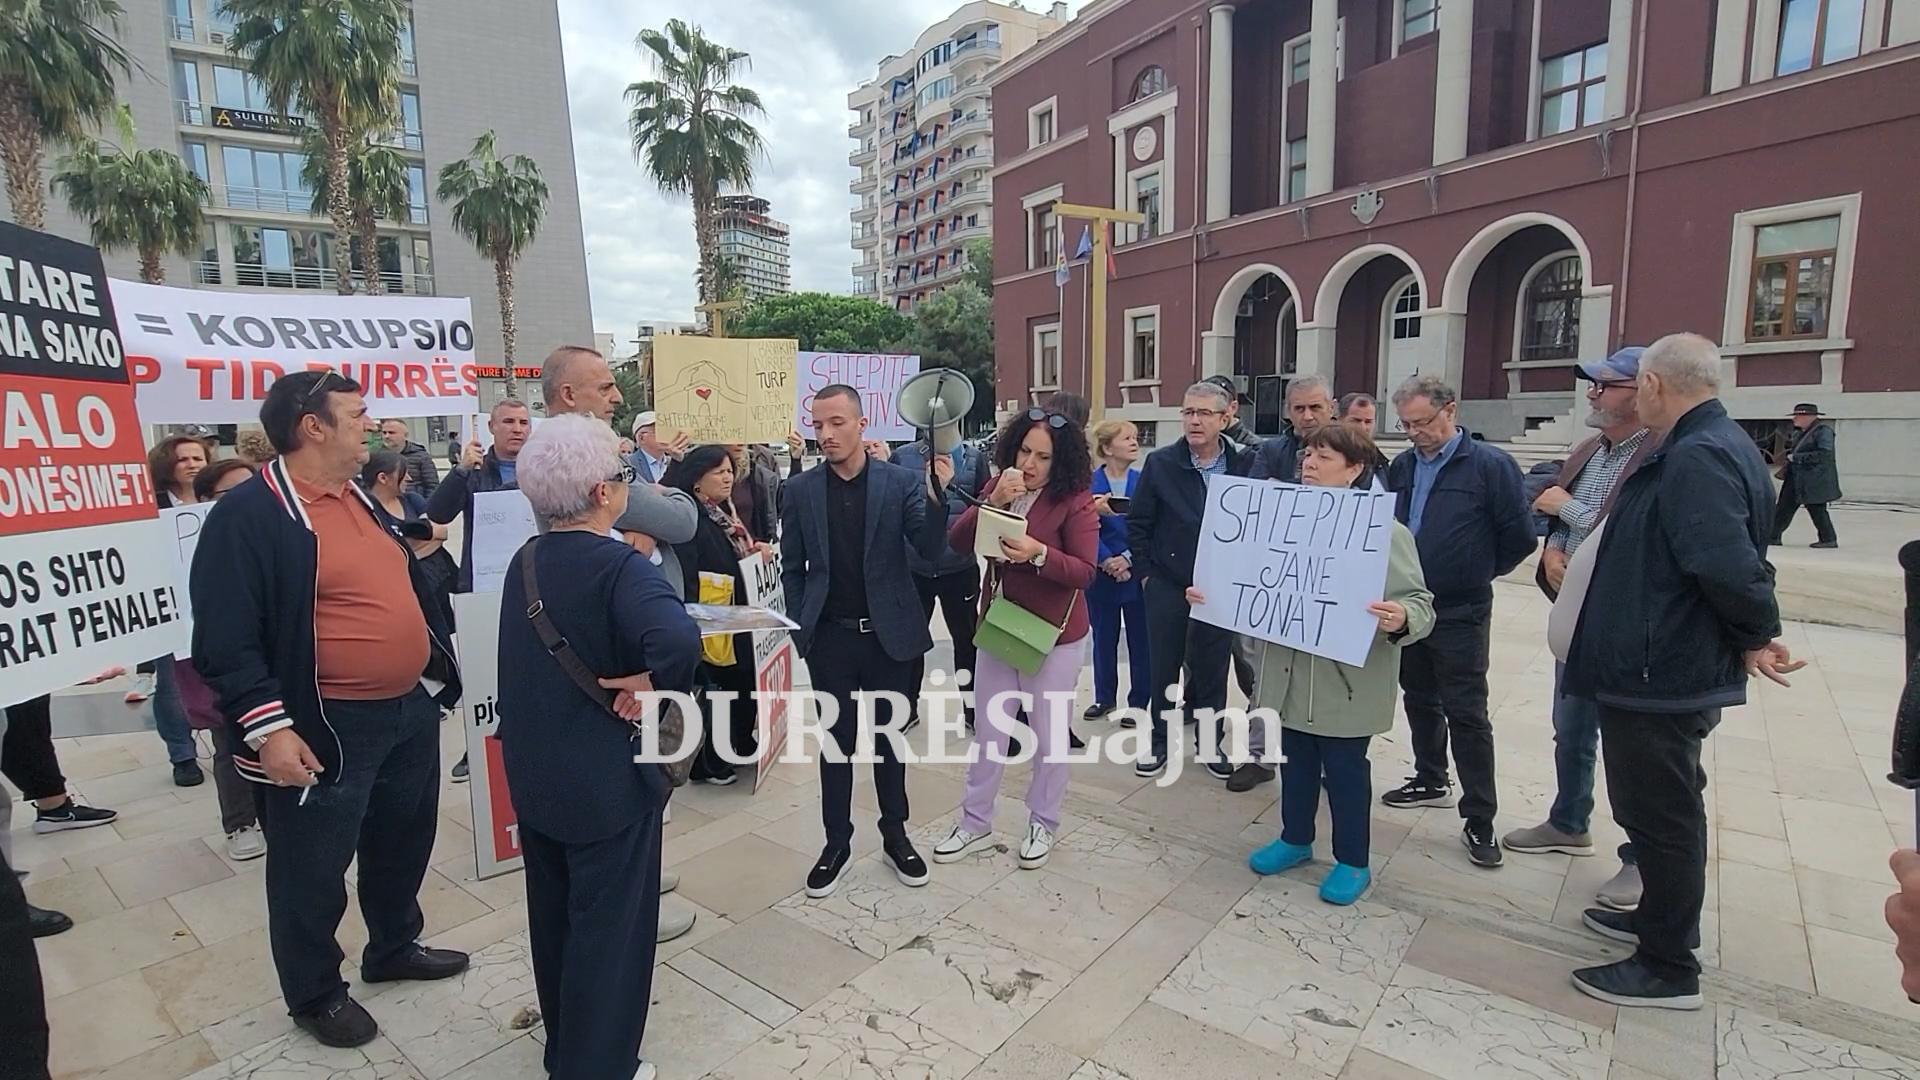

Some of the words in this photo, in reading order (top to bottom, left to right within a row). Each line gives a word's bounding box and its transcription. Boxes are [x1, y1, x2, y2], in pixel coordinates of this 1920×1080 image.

[234, 111, 302, 126] SULEJMNI
[41, 319, 122, 369] SAKO
[186, 312, 475, 351] KORRUPSIO
[186, 358, 287, 401] TID
[305, 356, 478, 400] URRËS
[755, 370, 787, 389] TURP
[808, 354, 912, 393] SHTEPITE
[4, 391, 116, 450] ALO
[48, 547, 125, 597] SHTO
[1260, 548, 1335, 595] JANE
[68, 586, 180, 648] PENALE!
[1232, 582, 1338, 647] TONAT
